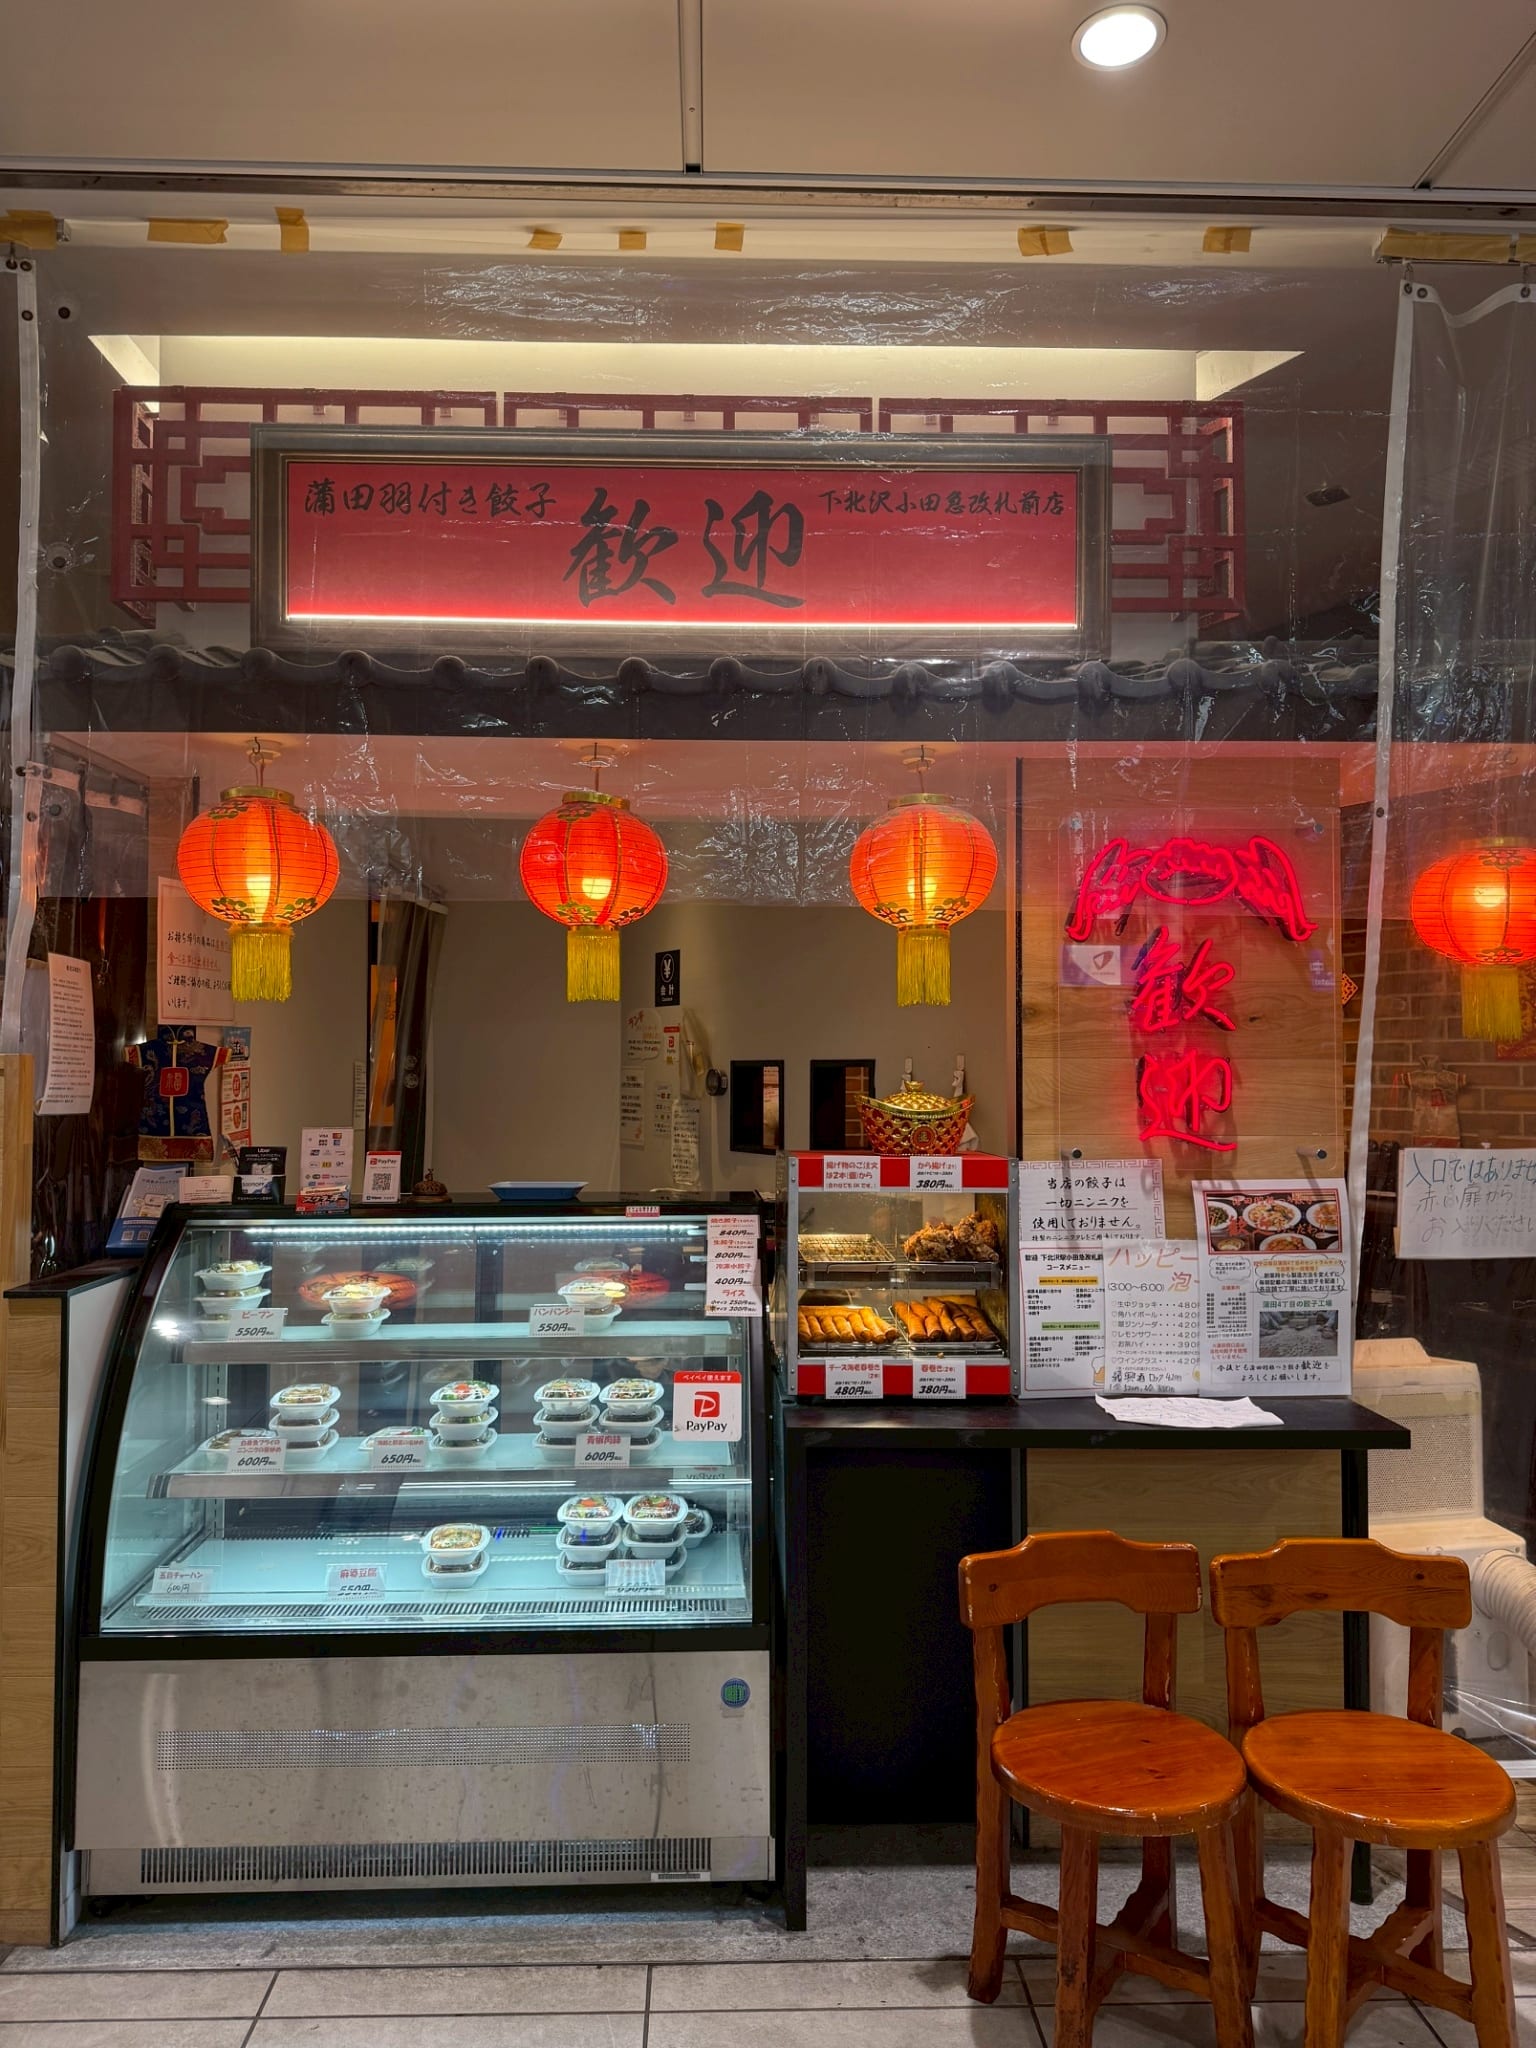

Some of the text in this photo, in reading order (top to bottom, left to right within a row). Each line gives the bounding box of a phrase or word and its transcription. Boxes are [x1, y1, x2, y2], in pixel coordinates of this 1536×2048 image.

[304, 477, 556, 518] 蒲田羽付き餃子
[818, 490, 1065, 516] 下北沢小田急改札前店
[563, 487, 806, 608] 歓迎
[1047, 1176, 1126, 1189] 当店の餃子は
[1045, 1197, 1129, 1208] 一切ニンニクを
[1032, 1216, 1141, 1229] 使用しておりません。
[722, 1289, 745, 1297] ライス
[242, 1311, 274, 1319] ビーフン
[534, 1308, 580, 1316] バンバンジー
[1241, 1373, 1321, 1381] よろしくお願いします。
[686, 1421, 727, 1432] PayPay
[160, 1571, 203, 1579] 五目チャーハン
[340, 1568, 377, 1578] 麻婆豆腐
[167, 1583, 190, 1593] 600円
